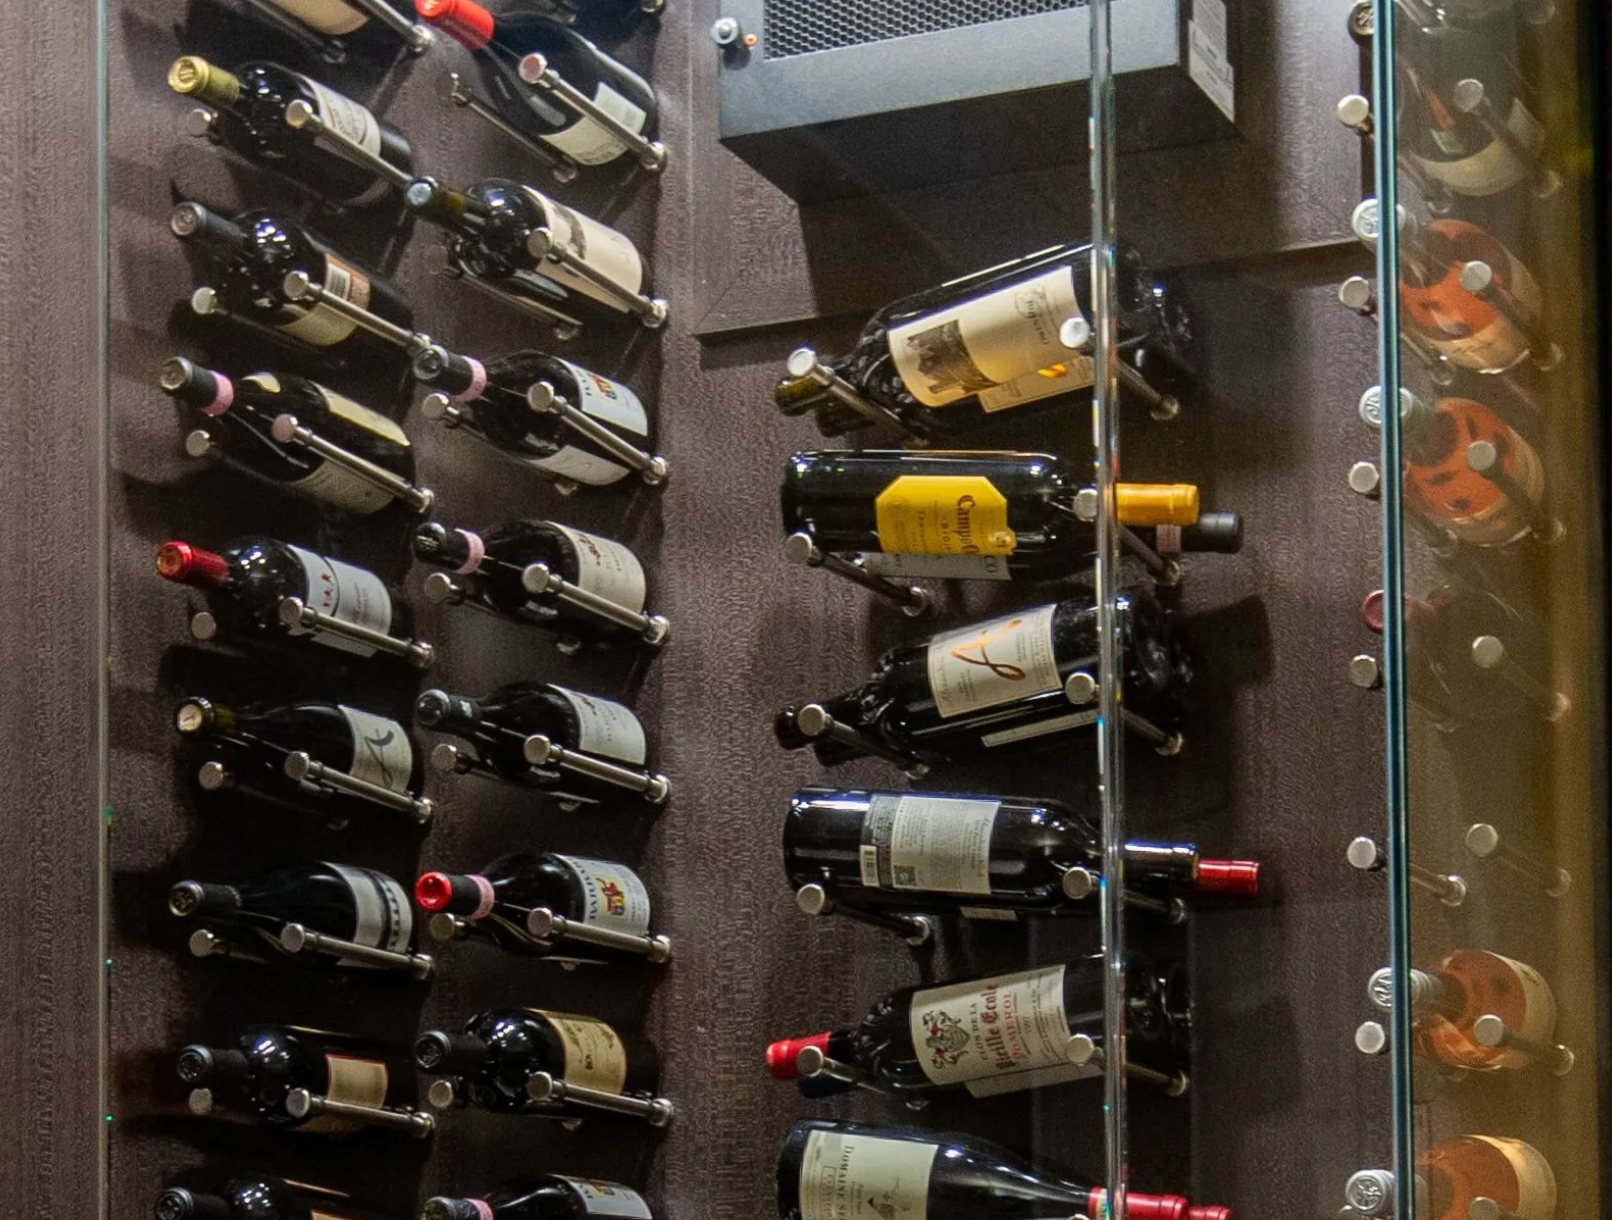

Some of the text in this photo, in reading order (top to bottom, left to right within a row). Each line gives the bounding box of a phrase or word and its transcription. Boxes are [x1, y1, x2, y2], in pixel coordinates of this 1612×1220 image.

[969, 1002, 988, 1061] CLOS DE LA
[1002, 990, 1024, 1060] POMEROL
[837, 1145, 855, 1199] DOMAINE
